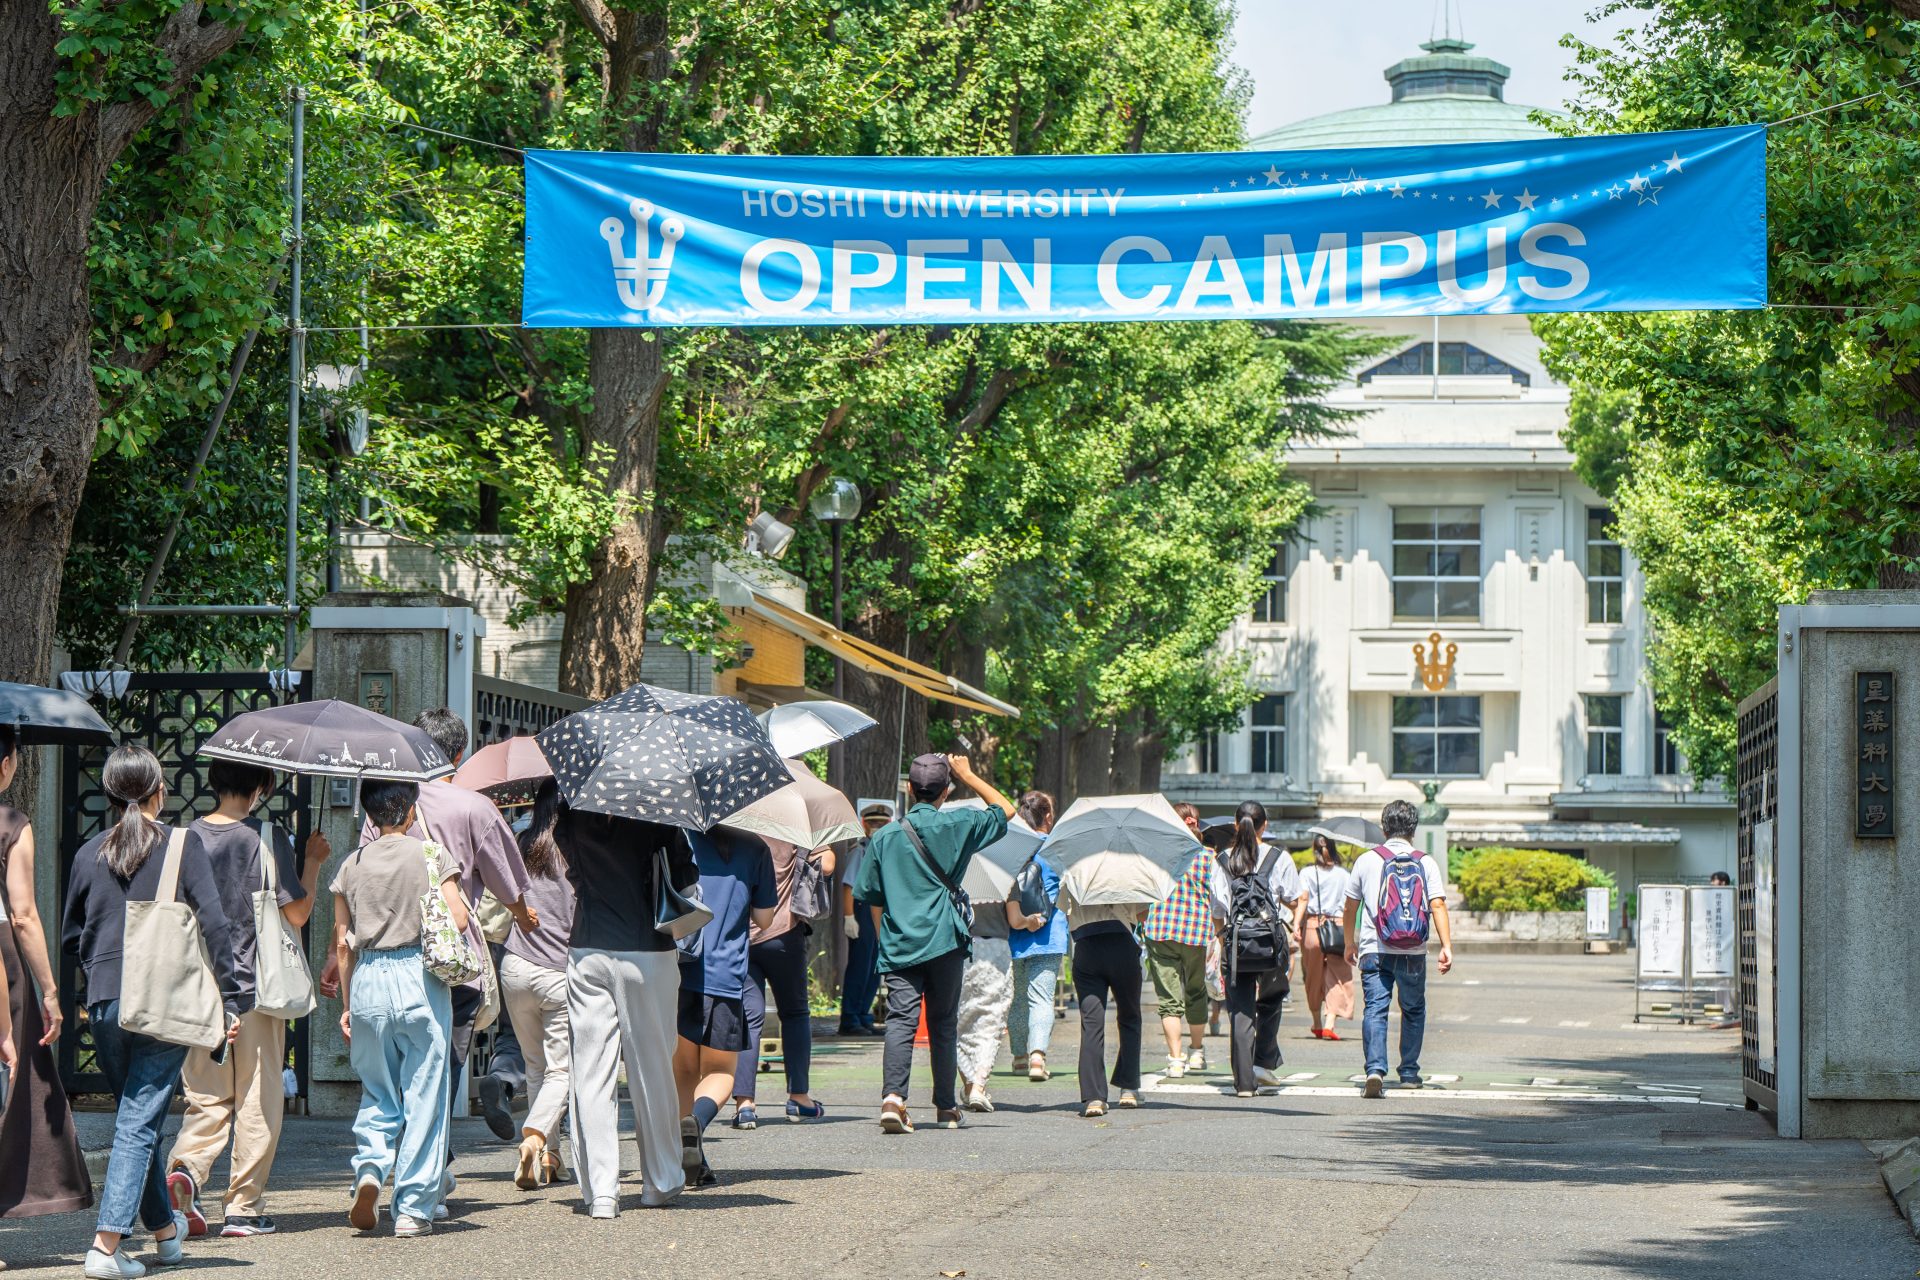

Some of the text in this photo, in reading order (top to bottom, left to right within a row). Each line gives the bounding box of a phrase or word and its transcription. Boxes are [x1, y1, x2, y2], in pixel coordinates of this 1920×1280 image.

[742, 187, 1125, 218] HOSHI UNIVERSITY
[739, 222, 1591, 315] OPEN CAMPUS
